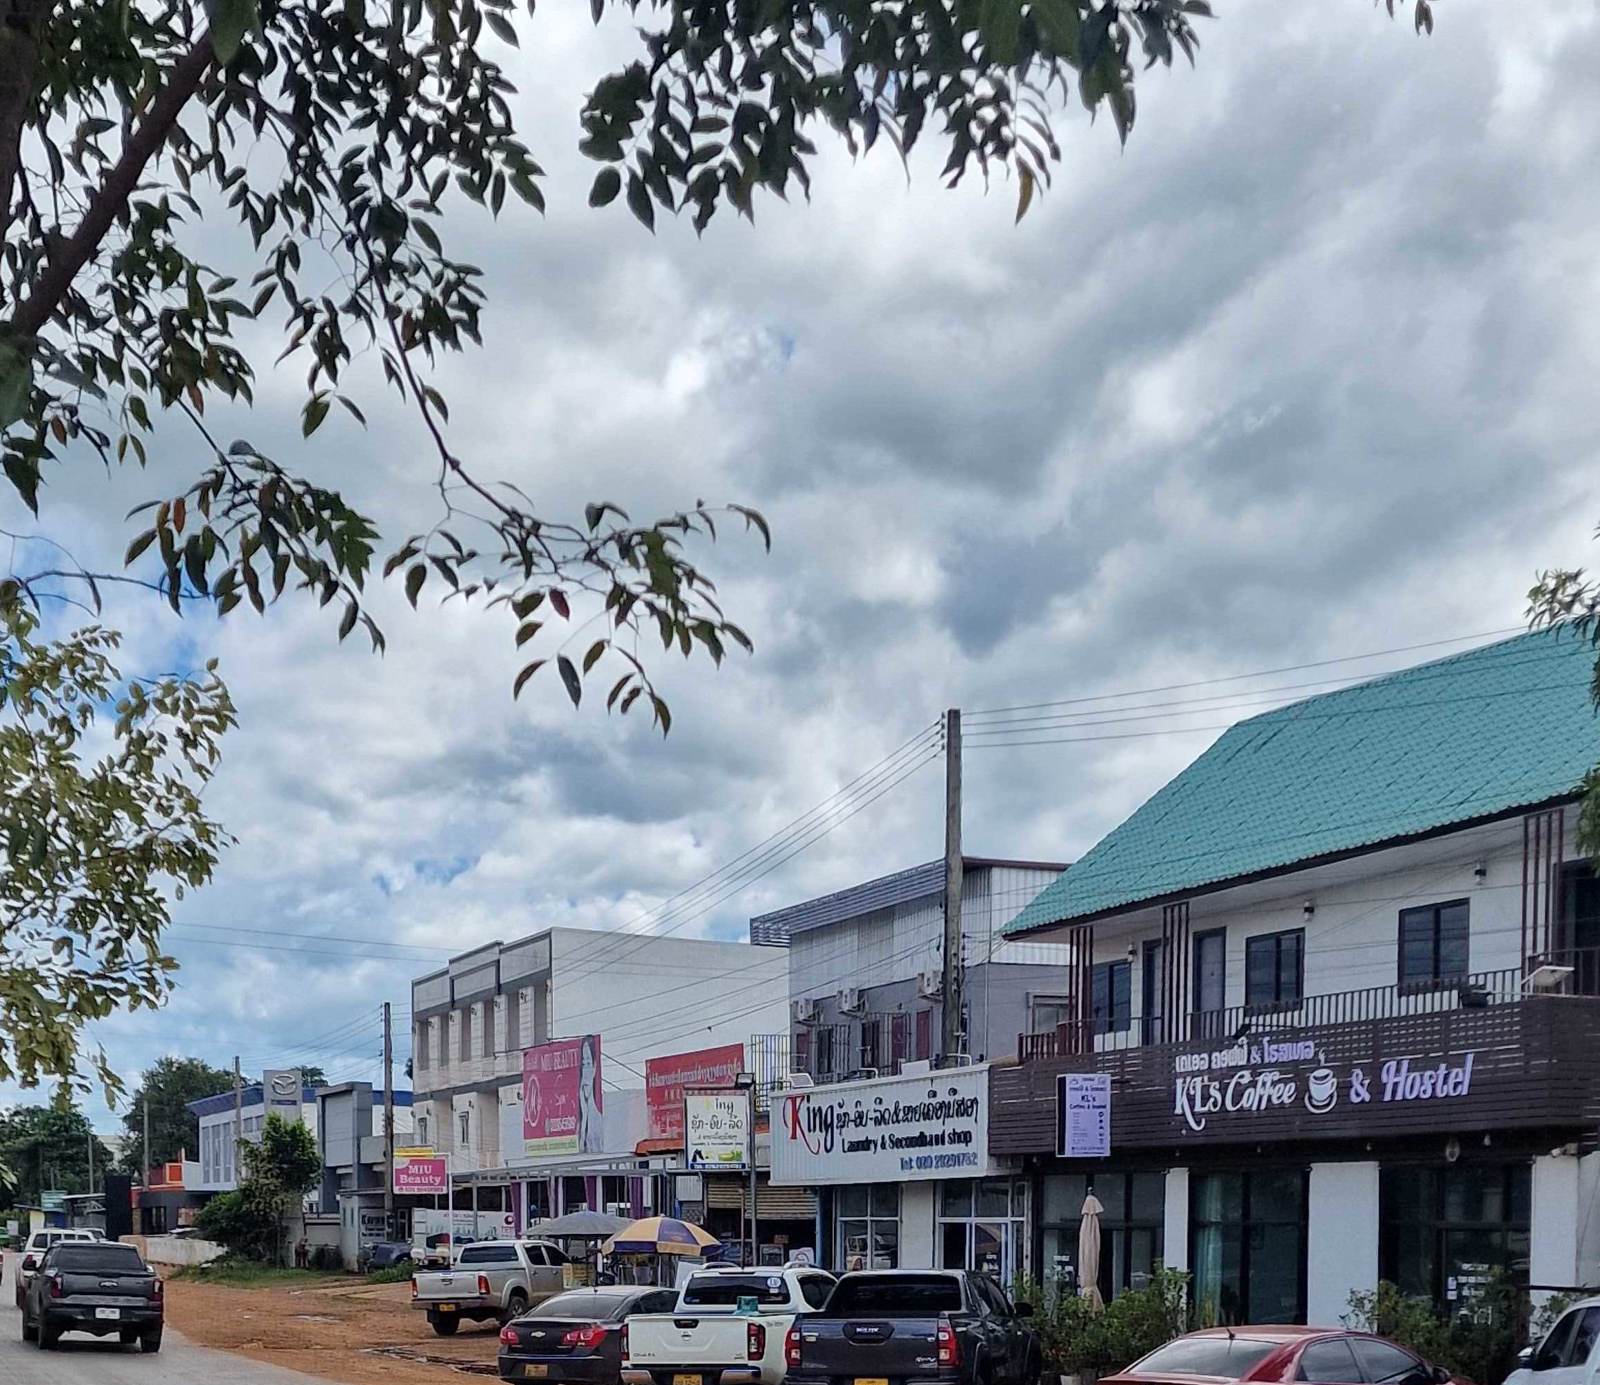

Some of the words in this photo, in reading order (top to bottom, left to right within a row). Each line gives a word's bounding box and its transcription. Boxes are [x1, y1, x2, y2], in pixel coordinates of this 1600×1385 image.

[1174, 1075, 1222, 1131] KL's
[1225, 1070, 1297, 1111] Coffee
[1350, 1068, 1372, 1103] &
[1380, 1053, 1475, 1101] Hostel
[782, 1093, 835, 1156] King
[947, 1128, 972, 1147] shop
[408, 1164, 432, 1175] MIU
[399, 1174, 442, 1186] Beauty
